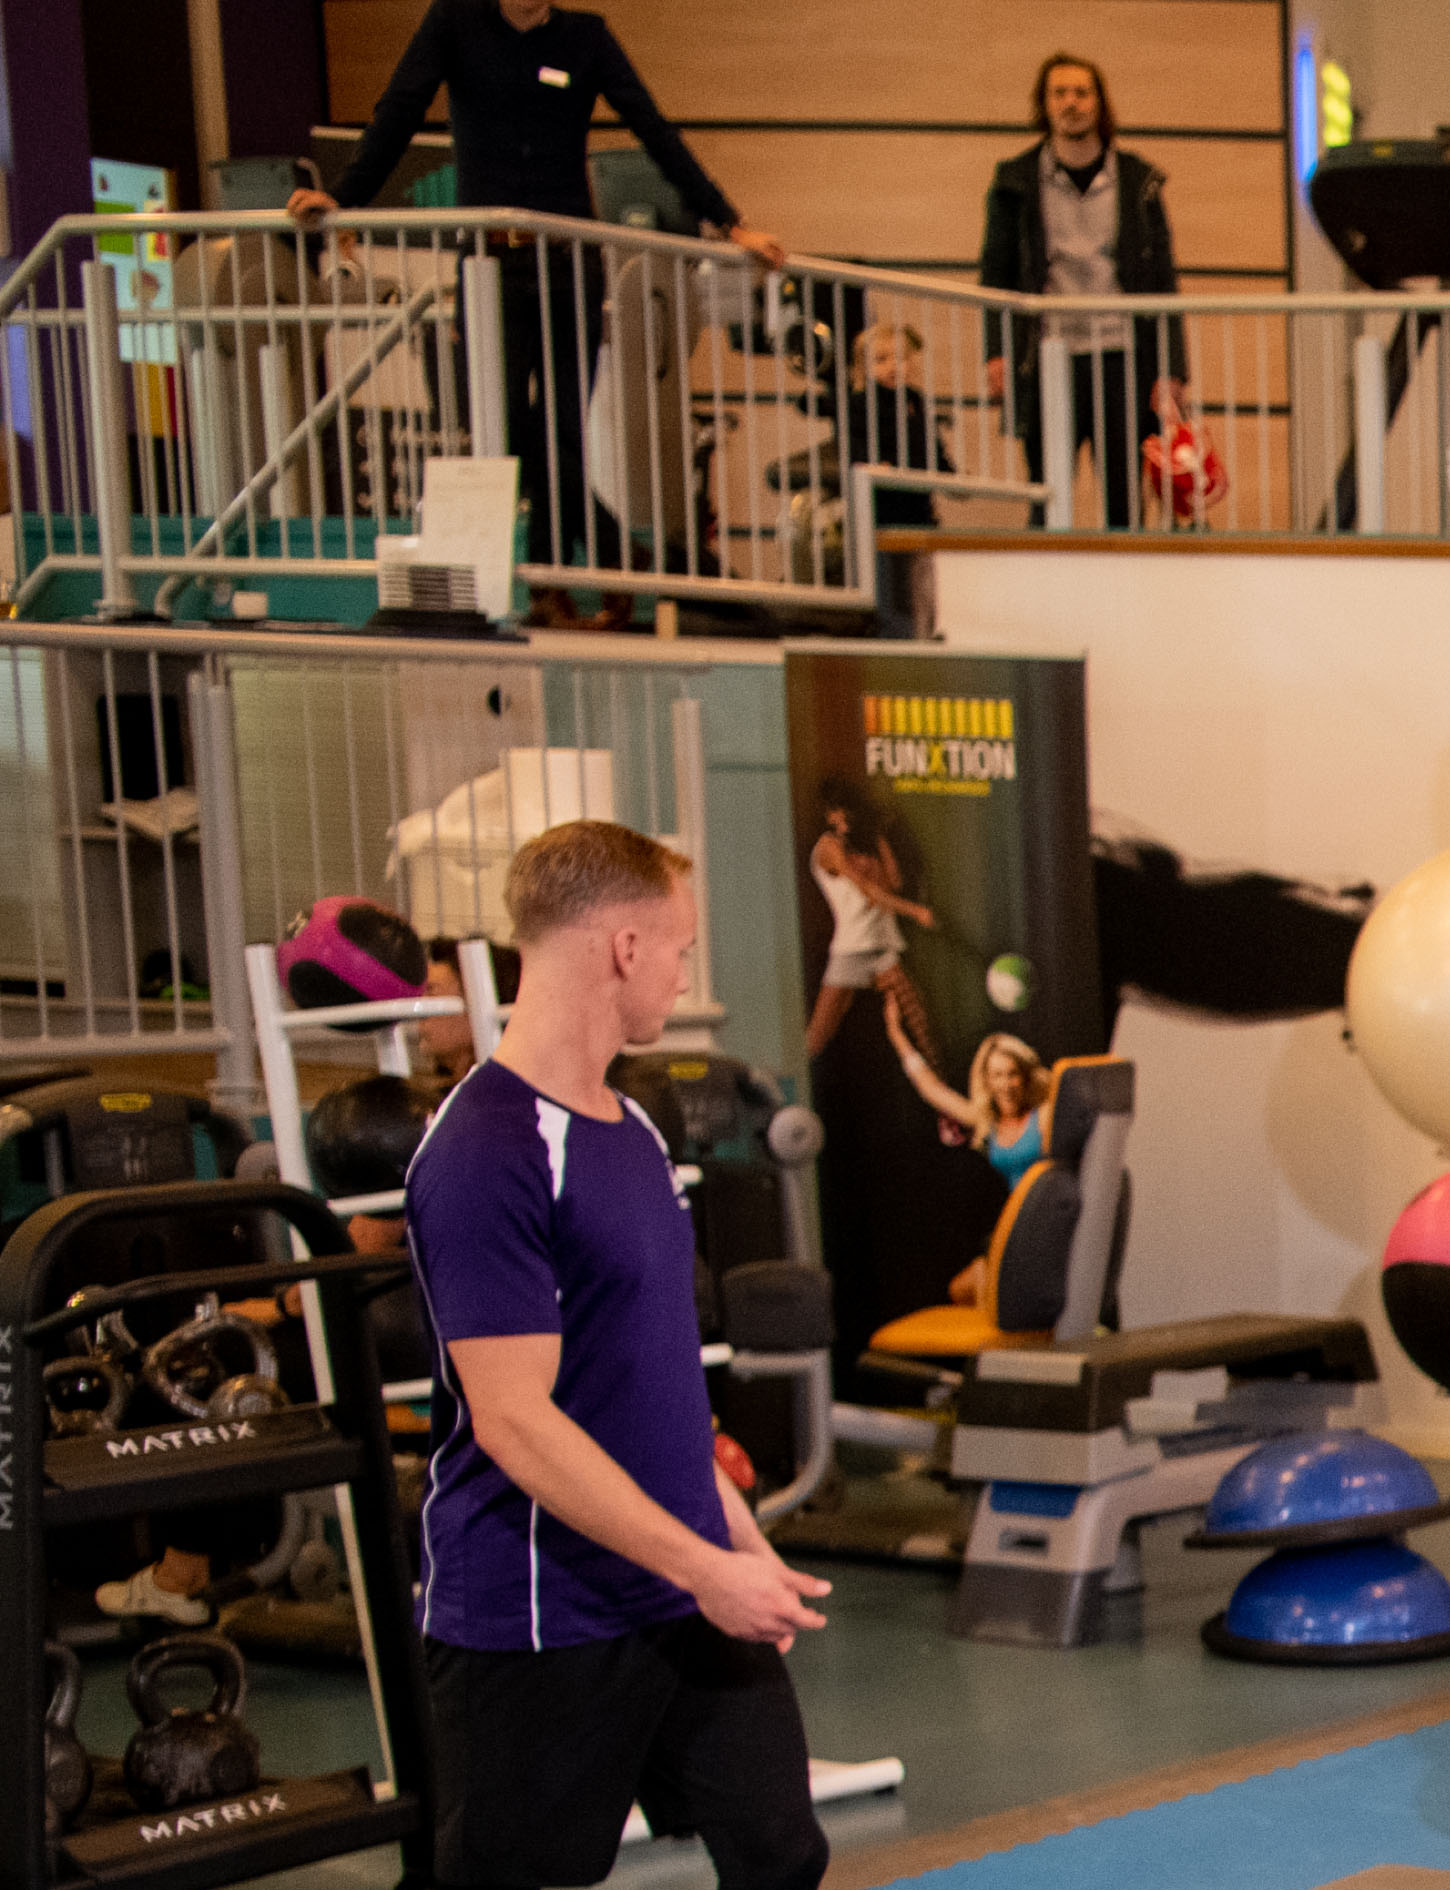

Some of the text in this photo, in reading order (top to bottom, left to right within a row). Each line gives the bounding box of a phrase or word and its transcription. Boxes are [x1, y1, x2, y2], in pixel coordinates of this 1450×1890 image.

[865, 737, 1017, 781] FUNXTION
[106, 1420, 257, 1459] MATRIX
[139, 1793, 286, 1843] MATRIX
